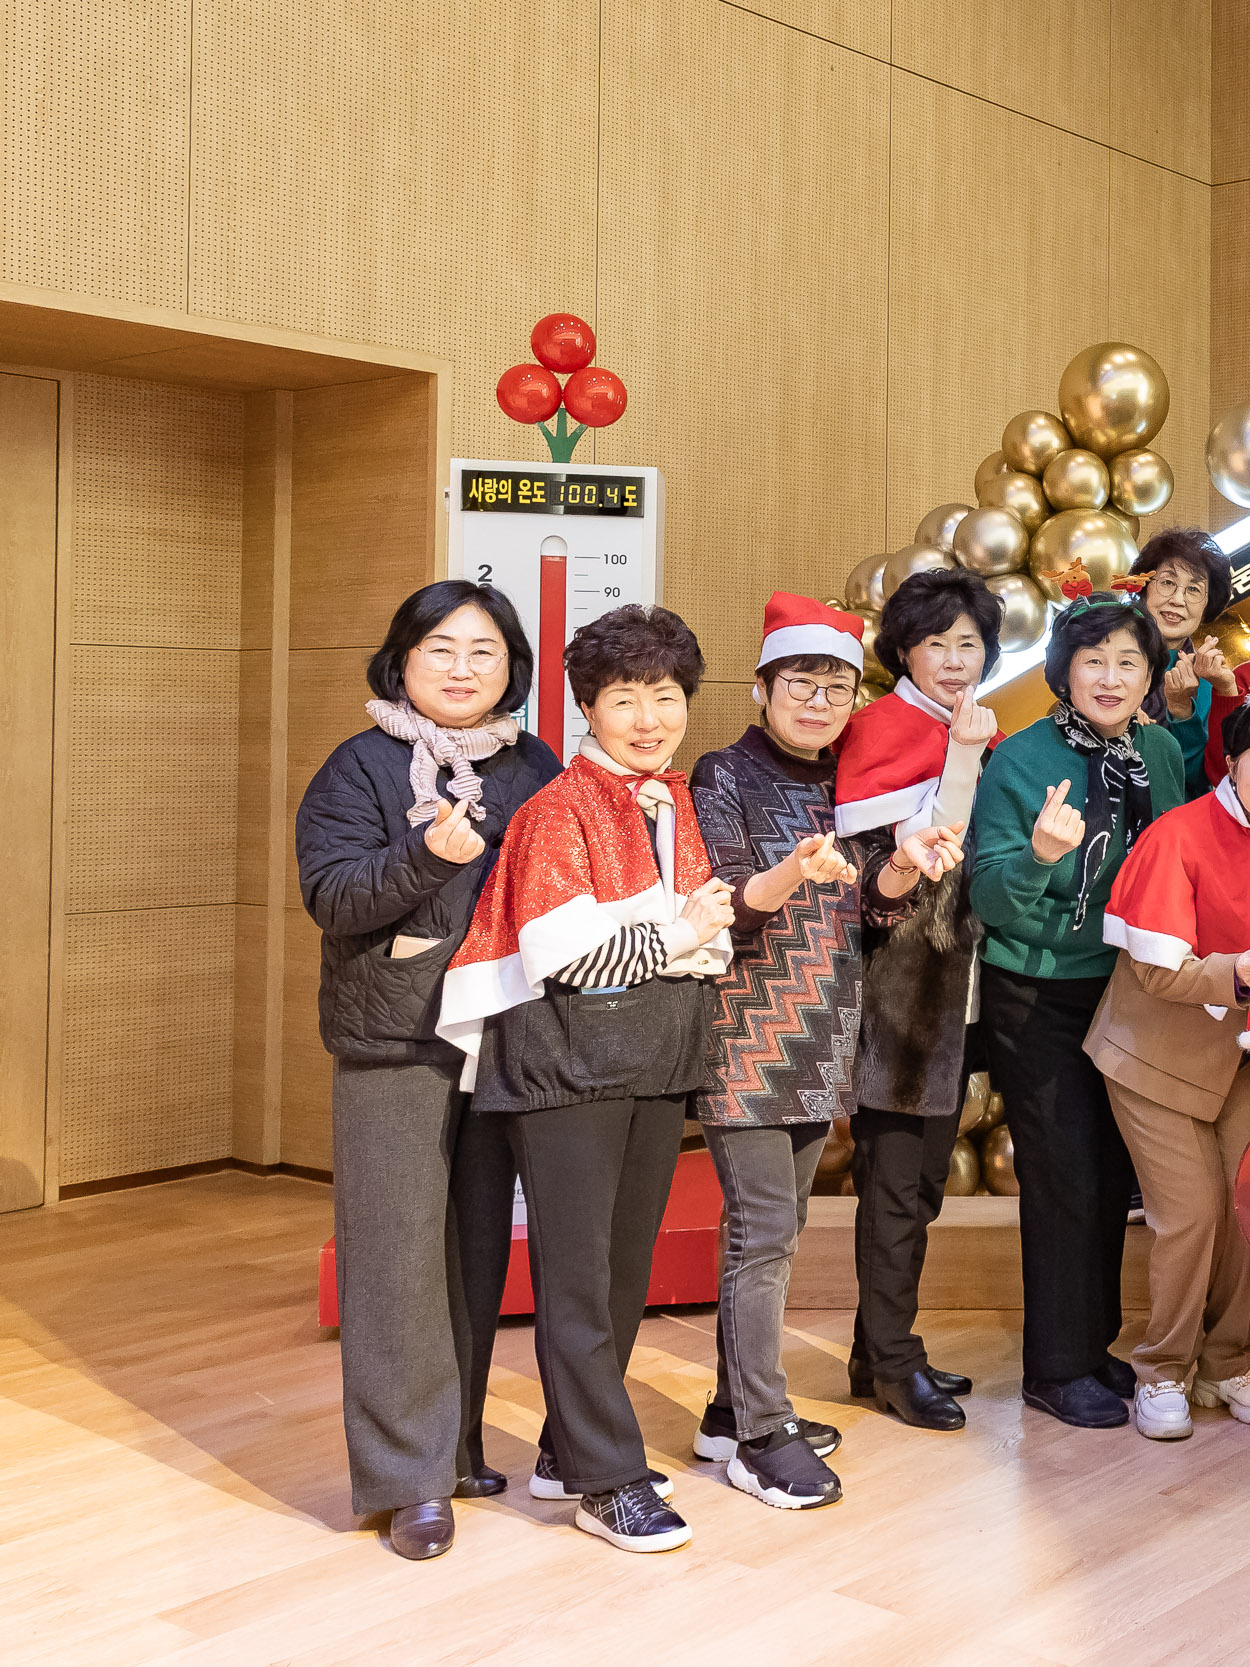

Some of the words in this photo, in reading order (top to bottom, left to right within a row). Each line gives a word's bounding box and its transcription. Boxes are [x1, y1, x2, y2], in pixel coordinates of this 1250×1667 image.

[468, 477, 512, 504] 사랑의
[517, 478, 546, 504] 온도
[603, 554, 627, 565] 100
[604, 587, 621, 598] 90
